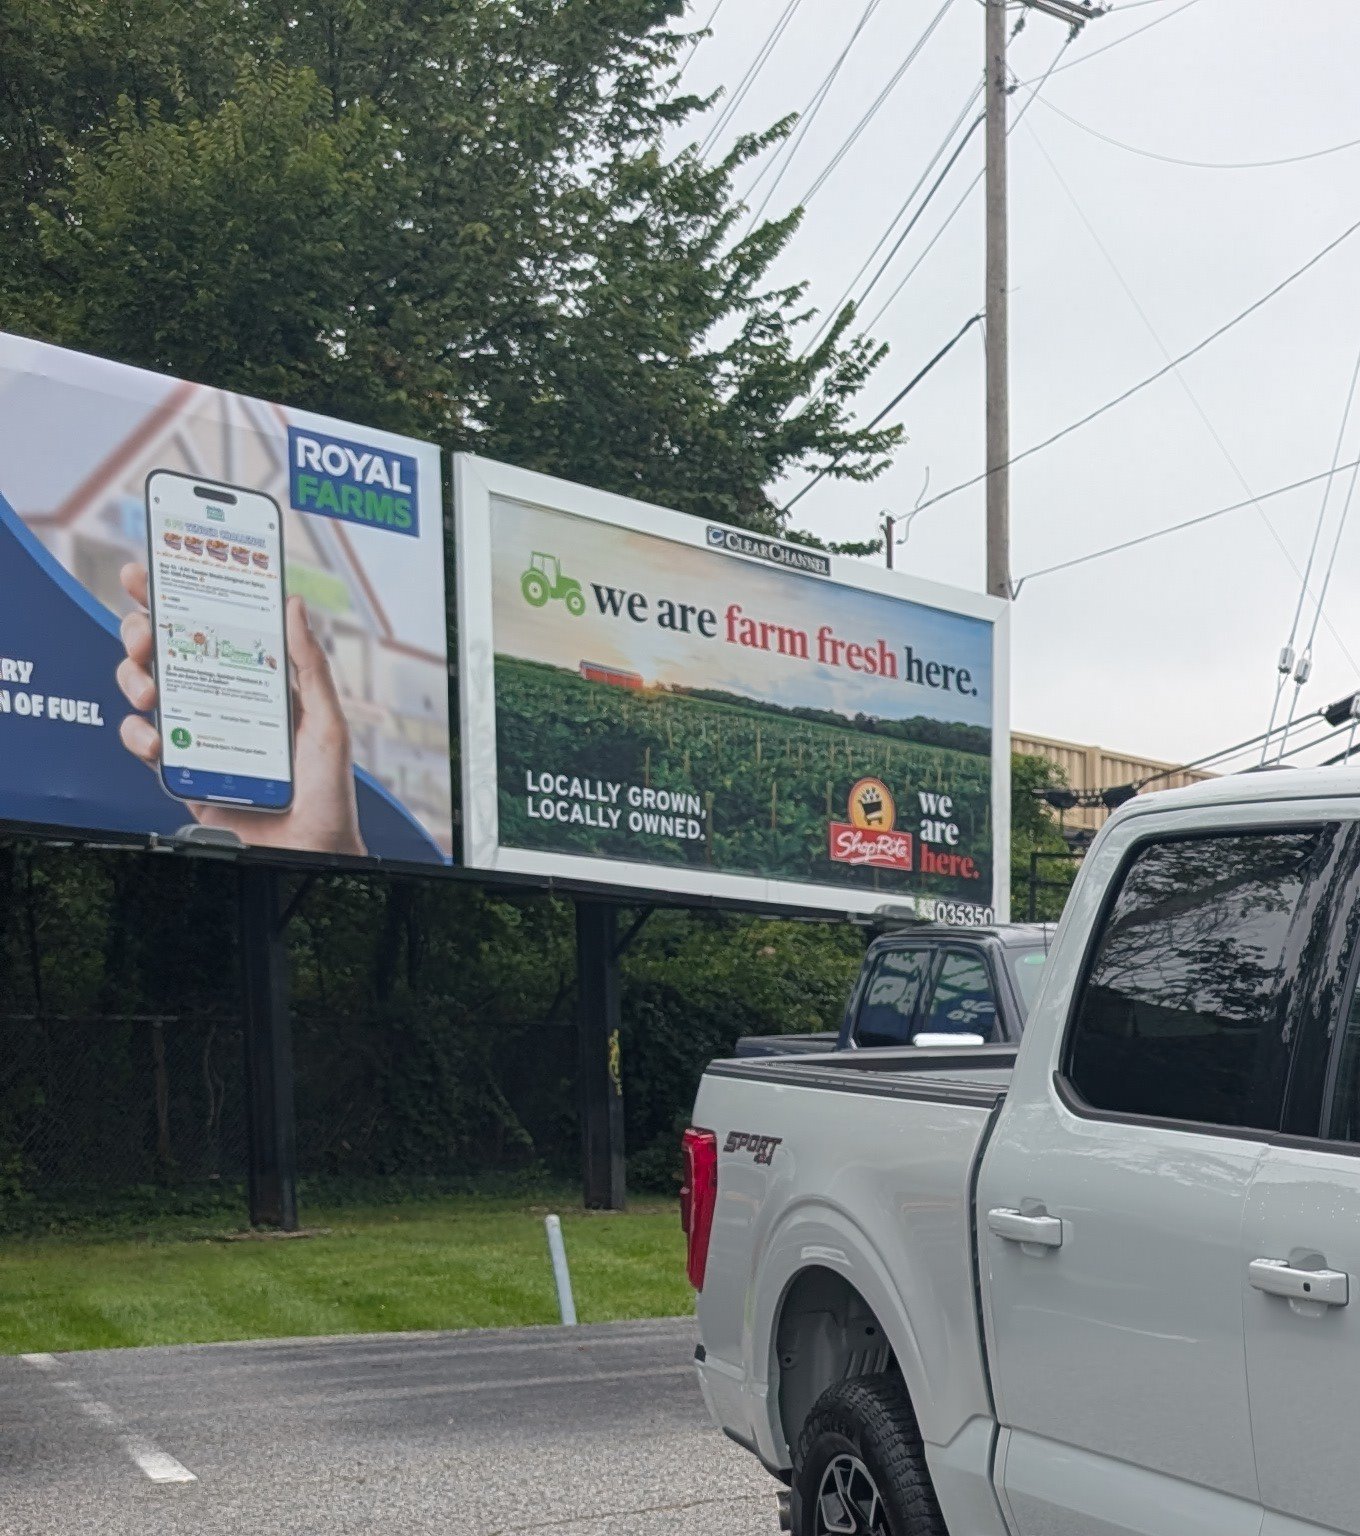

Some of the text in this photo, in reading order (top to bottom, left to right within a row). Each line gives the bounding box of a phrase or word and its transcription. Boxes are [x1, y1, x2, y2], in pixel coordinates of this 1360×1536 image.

[297, 436, 412, 494] ROYAL
[298, 474, 412, 528] FARMS
[589, 582, 978, 696] we are farm fresh here.
[0, 657, 34, 684] RY
[15, 692, 44, 717] OF
[48, 696, 105, 727] FUEL
[526, 769, 707, 820] LOCALLY GROWN,
[918, 791, 953, 818] we
[527, 796, 707, 841] LOCALLY OWNED.
[919, 818, 960, 846] are
[834, 830, 908, 867] ShopRite
[919, 843, 981, 880] here.
[935, 901, 994, 926] 035350
[723, 1131, 783, 1162] SPORT
